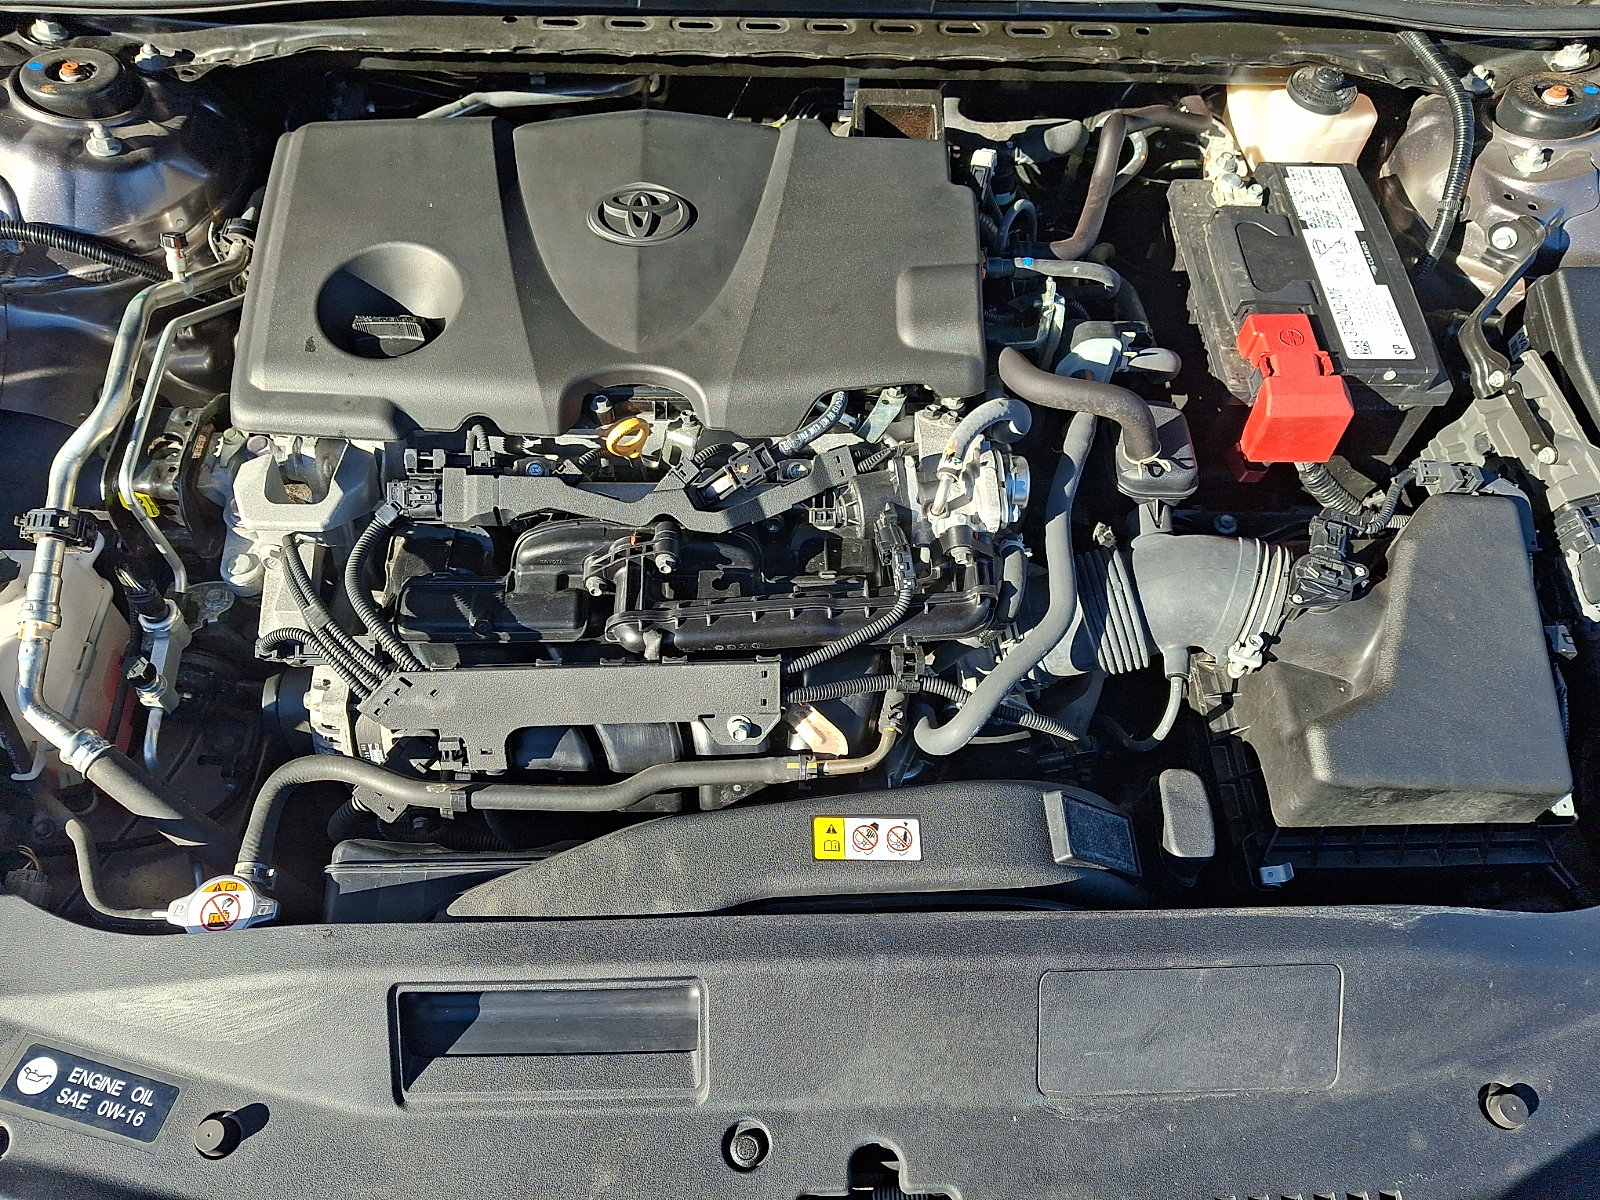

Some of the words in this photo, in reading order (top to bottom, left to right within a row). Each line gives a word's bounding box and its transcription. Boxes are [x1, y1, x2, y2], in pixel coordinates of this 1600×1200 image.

[1360, 240, 1375, 266] CLARIOS
[1392, 344, 1409, 355] SP
[67, 1066, 127, 1097] ENGINE
[130, 1086, 154, 1107] OIL
[56, 1087, 92, 1111] SAE
[97, 1100, 146, 1127] 0W-16
